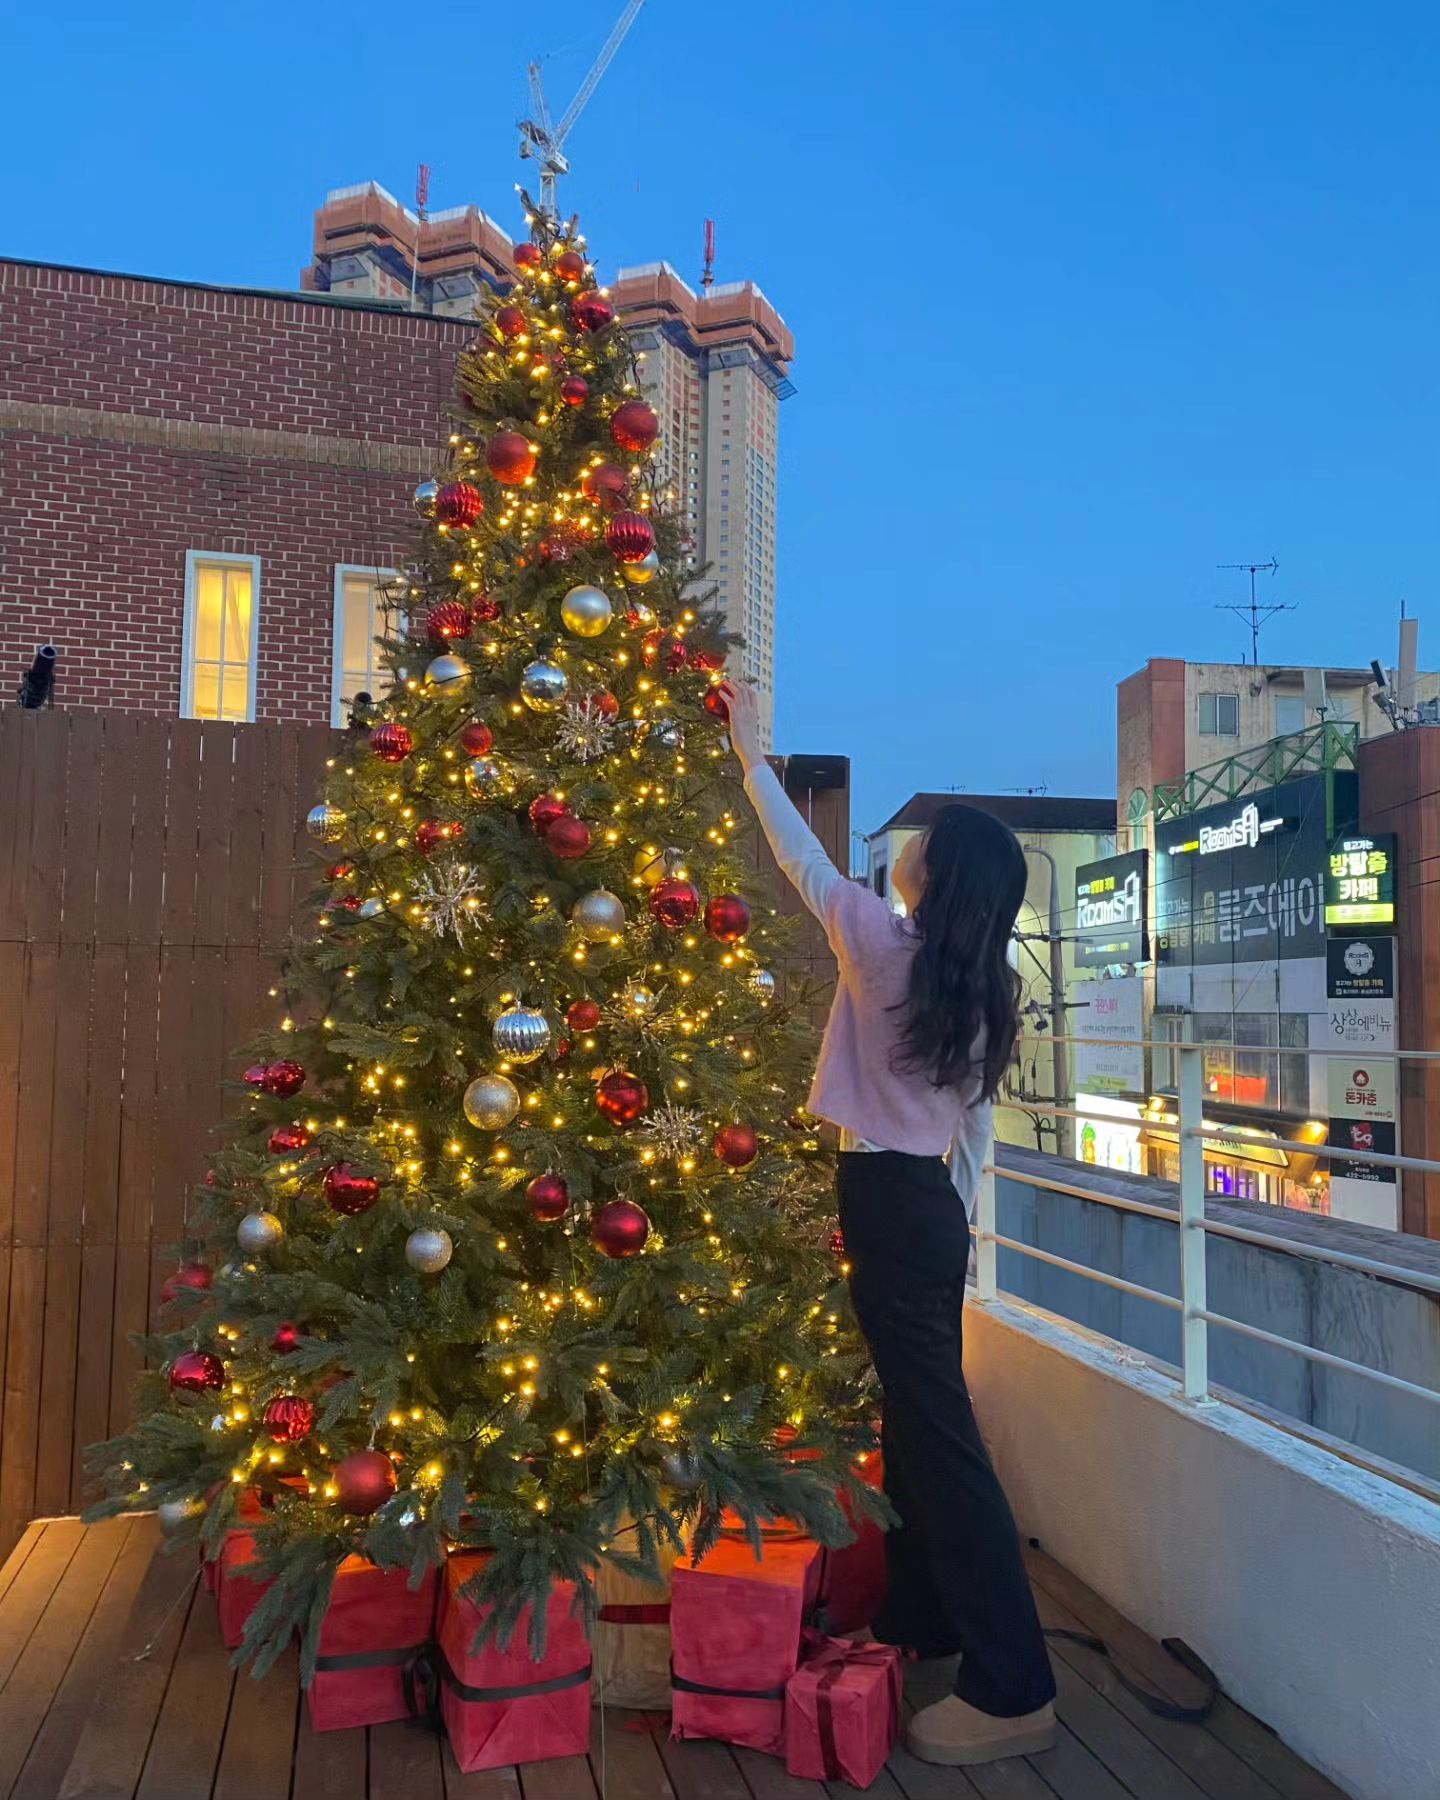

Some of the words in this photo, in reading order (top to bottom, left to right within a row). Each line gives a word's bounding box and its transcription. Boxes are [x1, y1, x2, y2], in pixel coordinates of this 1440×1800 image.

[1339, 877, 1379, 902] 카페
[1218, 872, 1325, 943] 룸즈에이
[1330, 1007, 1392, 1035] 상상에비뉴
[1344, 1091, 1377, 1107] 돈카춘
